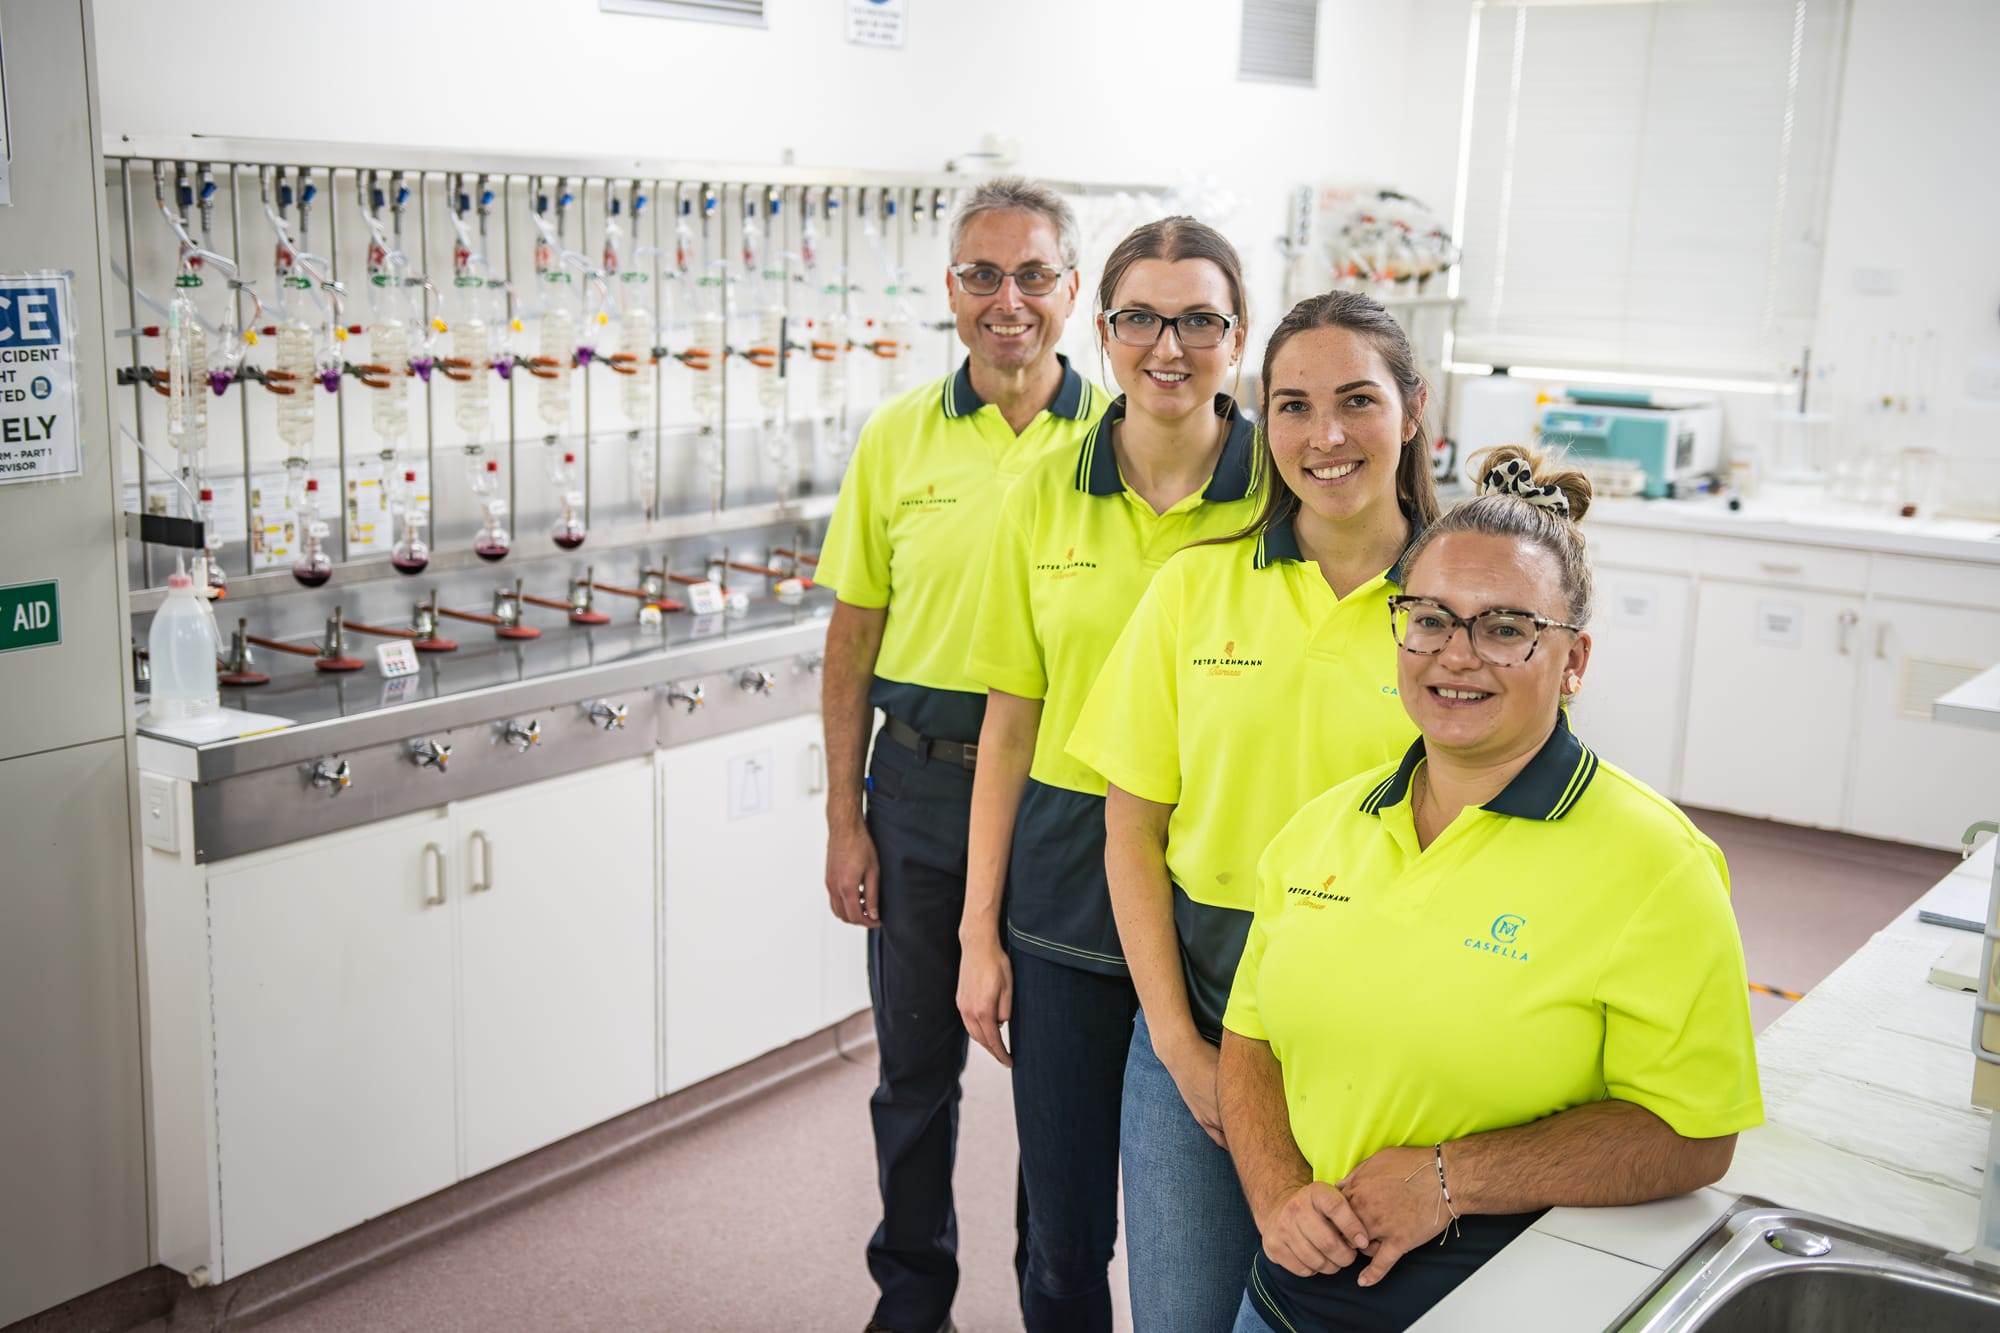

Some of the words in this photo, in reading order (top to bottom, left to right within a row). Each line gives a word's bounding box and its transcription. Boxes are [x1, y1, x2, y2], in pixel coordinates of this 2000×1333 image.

[0, 347, 60, 364] CIDENT
[2, 414, 57, 443] ELY
[21, 448, 46, 459] PART
[13, 600, 51, 632] AID
[1192, 658, 1217, 666] PETER
[1220, 658, 1263, 667] LEHMANN
[1464, 938, 1528, 961] CASELLA
